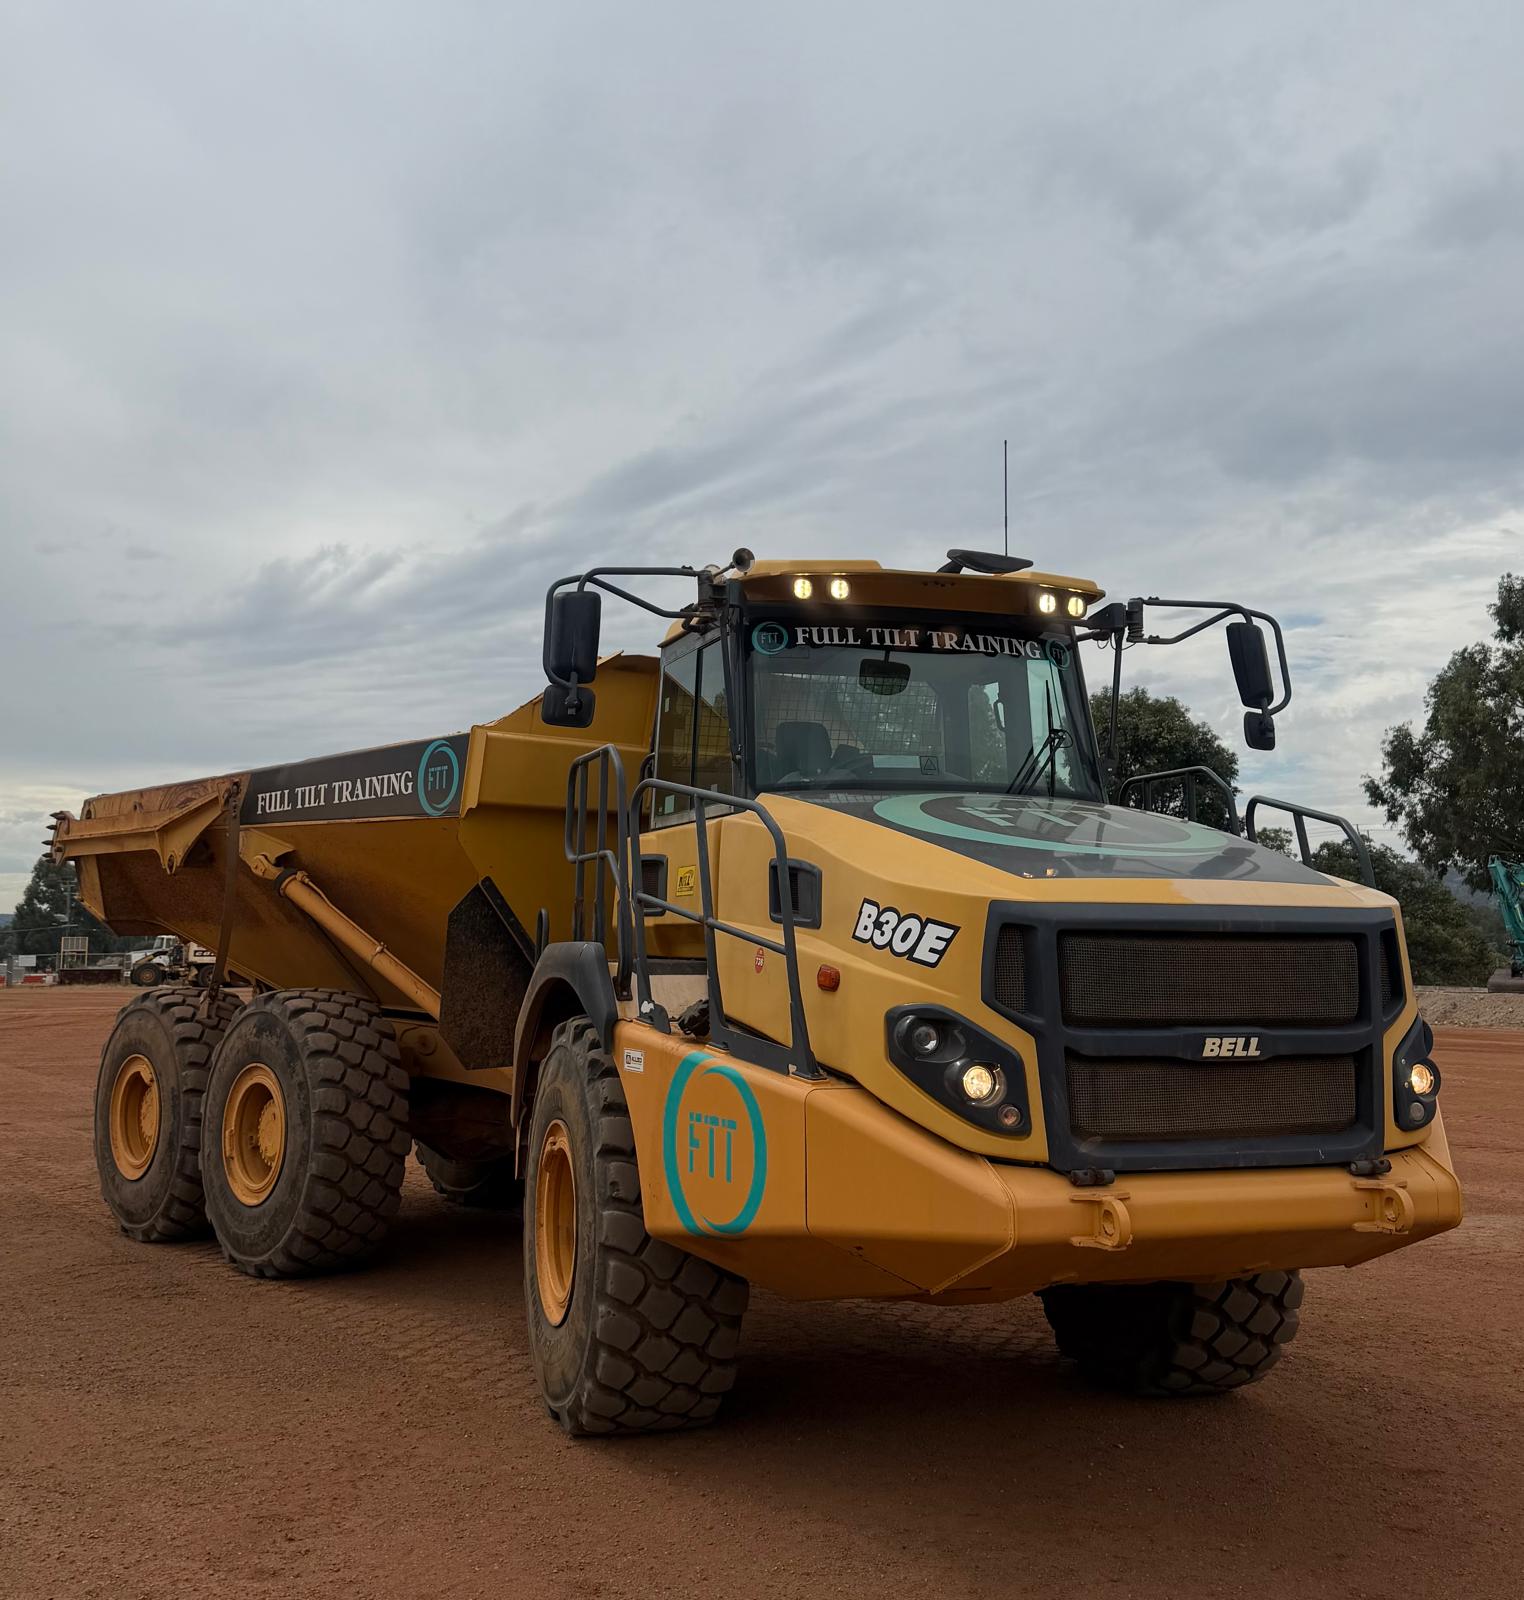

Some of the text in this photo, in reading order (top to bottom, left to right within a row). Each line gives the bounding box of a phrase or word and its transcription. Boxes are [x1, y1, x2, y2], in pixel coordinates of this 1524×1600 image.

[795, 627, 1041, 659] FULL TILT TRAINING
[257, 770, 414, 814] FULL TILT TRAINING
[428, 765, 448, 791] FTT
[852, 898, 960, 968] B30E
[1202, 1037, 1261, 1057] BELL
[688, 1111, 737, 1184] FTT
